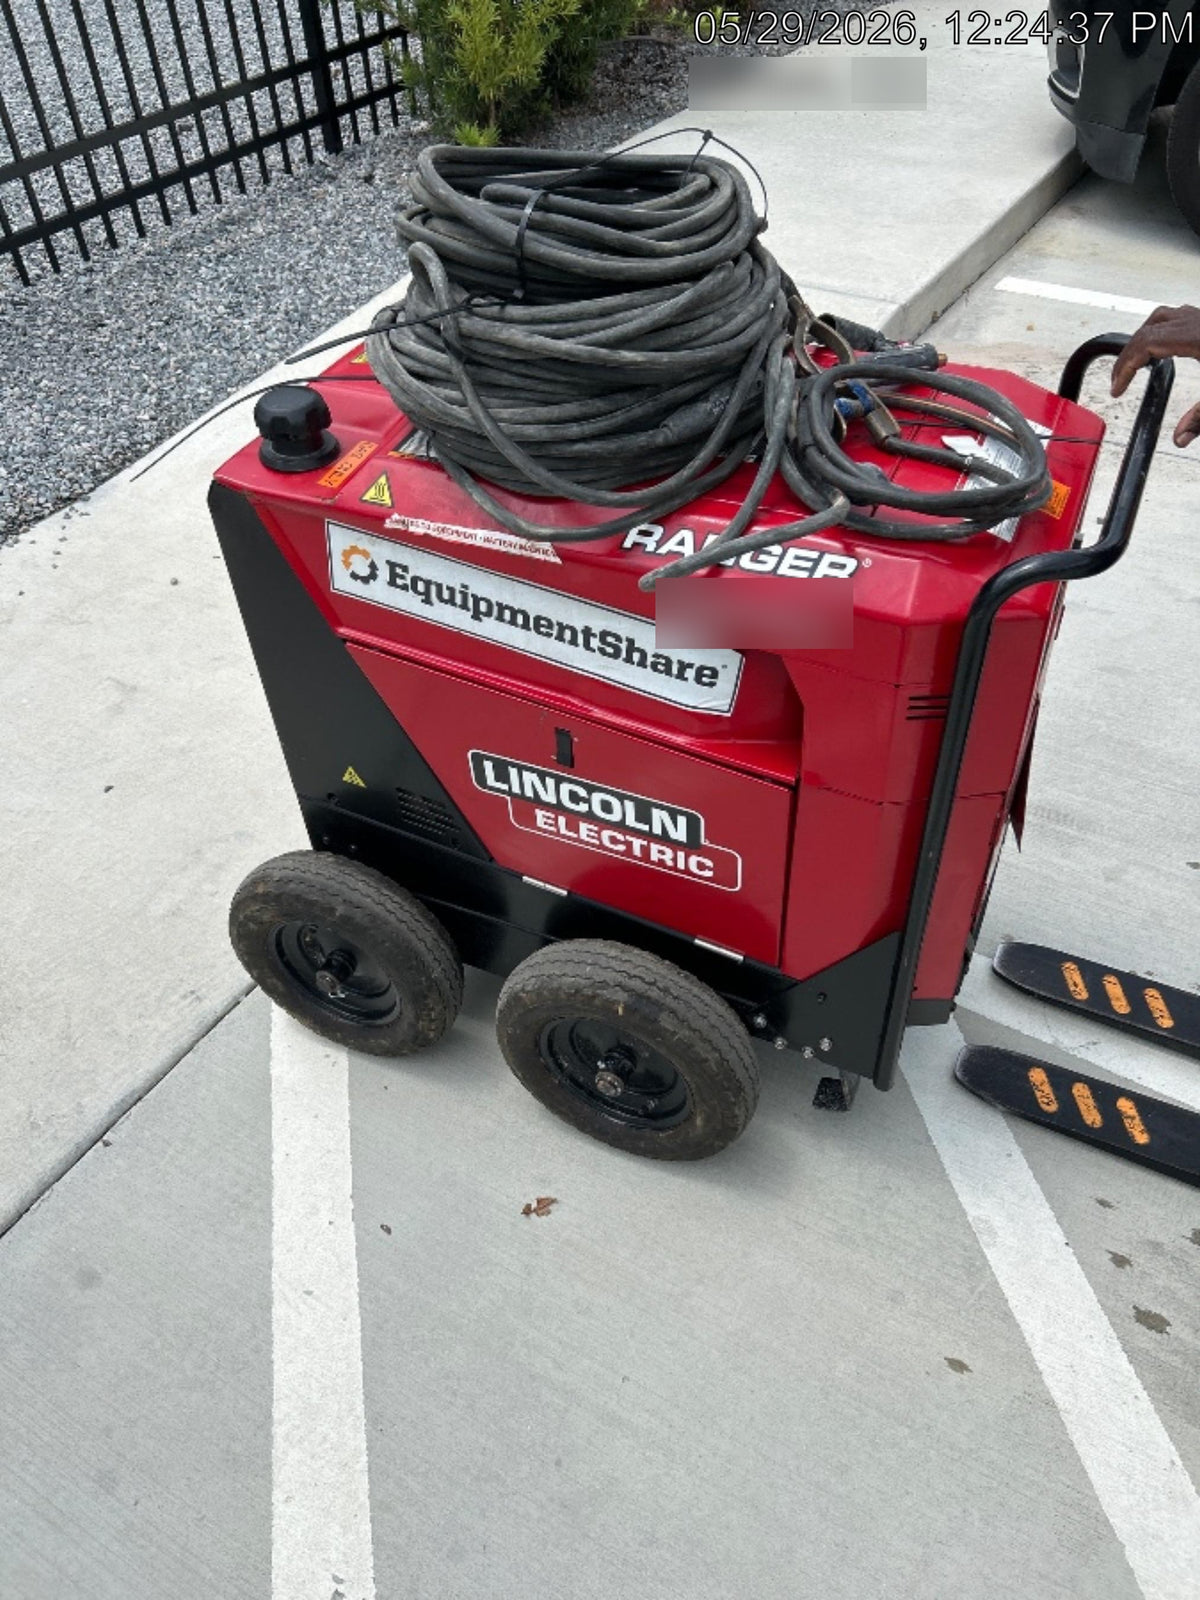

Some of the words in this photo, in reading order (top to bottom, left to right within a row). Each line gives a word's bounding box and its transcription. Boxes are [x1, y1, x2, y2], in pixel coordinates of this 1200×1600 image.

[385, 559, 719, 688] EquipmentShare
[483, 759, 688, 843] LINCOLN
[535, 808, 714, 877] ELECTRIC
